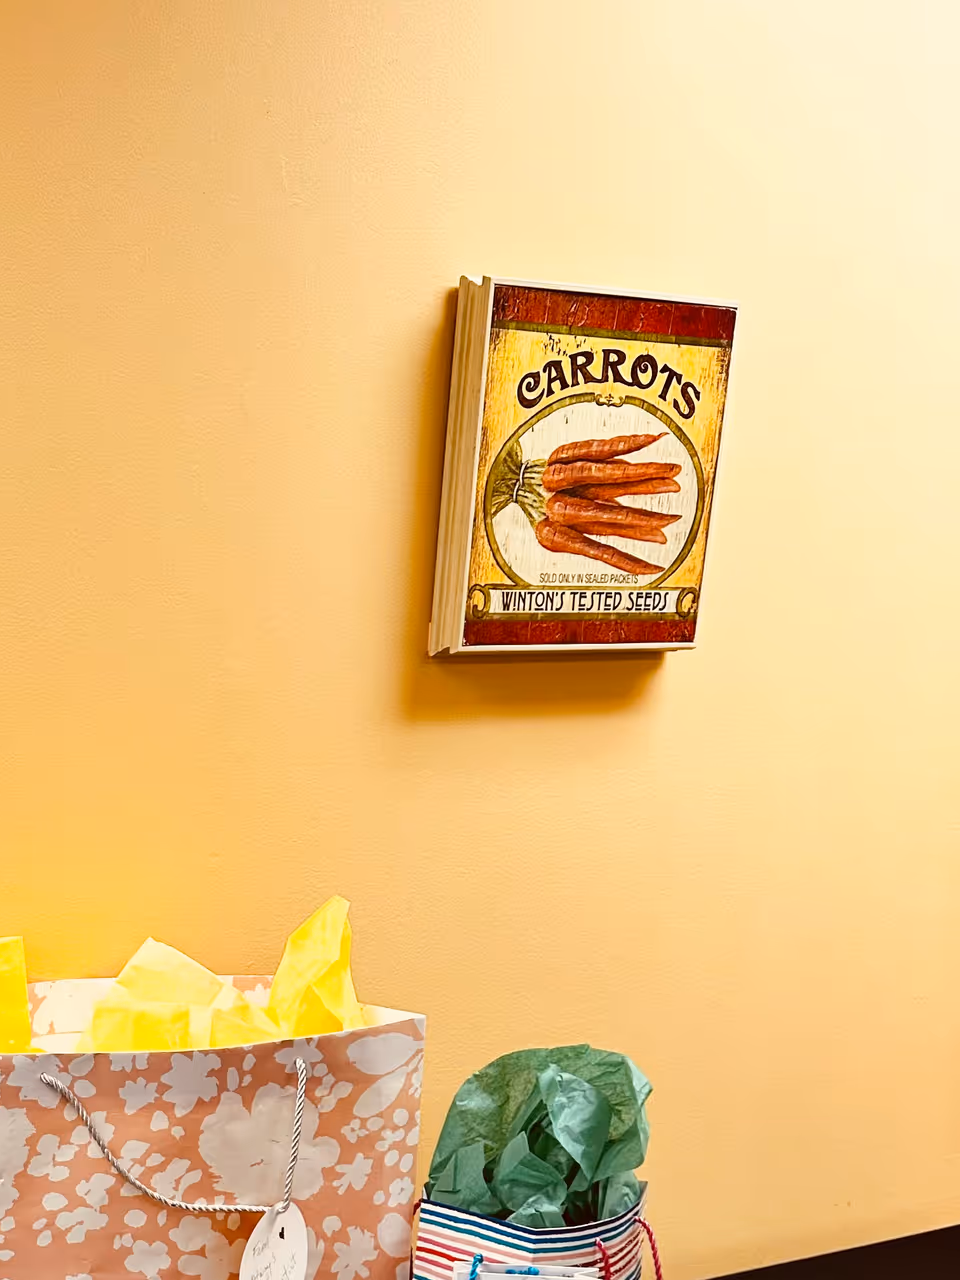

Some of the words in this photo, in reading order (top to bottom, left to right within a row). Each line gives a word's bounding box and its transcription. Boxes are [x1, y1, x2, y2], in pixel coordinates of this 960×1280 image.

[517, 348, 701, 420] CARROTS
[539, 573, 558, 584] SOLD
[558, 573, 576, 584] ONLY
[577, 574, 585, 583] IN
[585, 574, 609, 584] SEALED
[610, 574, 638, 584] PACKETS
[502, 592, 566, 612] WINTON'S
[570, 592, 623, 612] TESTED
[626, 592, 669, 612] SEEDS
